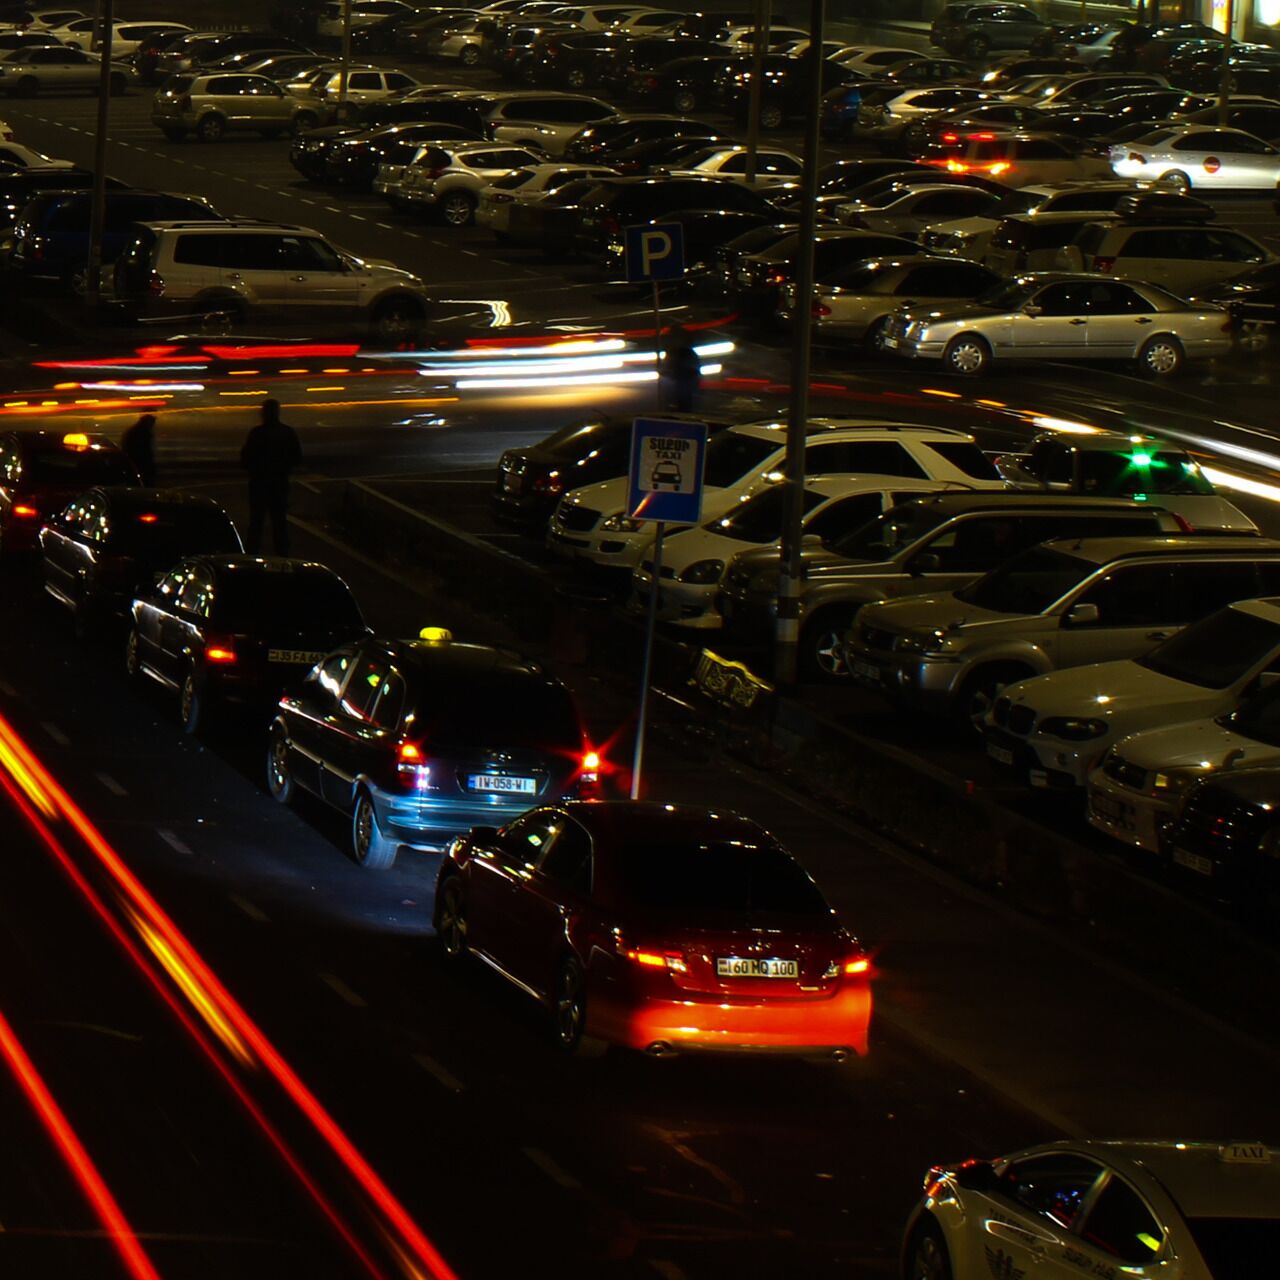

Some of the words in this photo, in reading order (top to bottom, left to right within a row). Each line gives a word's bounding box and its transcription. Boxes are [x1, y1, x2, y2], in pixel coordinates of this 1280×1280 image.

[641, 231, 672, 276] P
[654, 450, 683, 460] TAXI
[733, 961, 747, 974] 60
[773, 962, 795, 976] 100
[1232, 1146, 1263, 1158] TAXI
